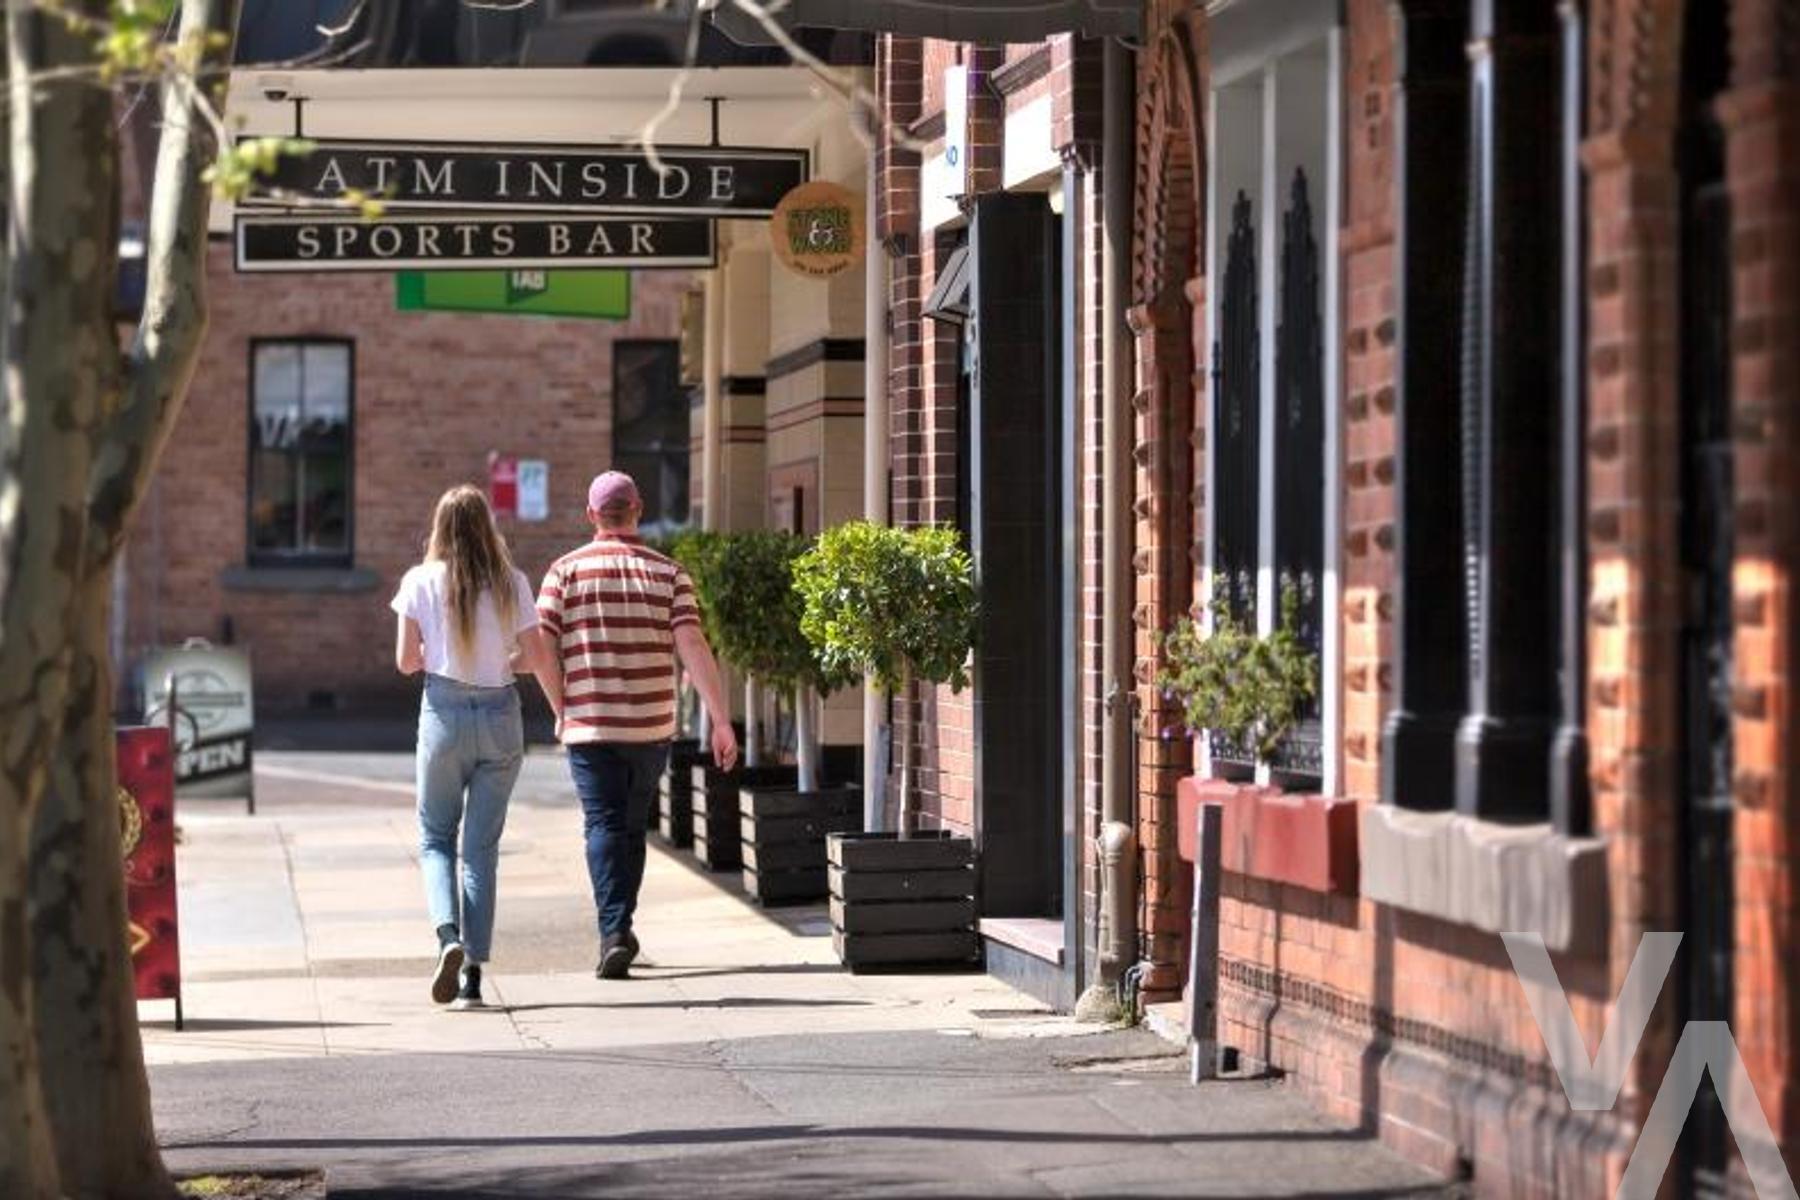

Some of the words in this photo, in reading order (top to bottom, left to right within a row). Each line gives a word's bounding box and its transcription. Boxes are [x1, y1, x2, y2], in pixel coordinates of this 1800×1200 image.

[314, 157, 457, 195] ATM
[496, 161, 736, 201] INSIDE
[298, 224, 516, 257] SPORTS
[549, 223, 656, 255] BAR
[175, 740, 246, 778] PEN
